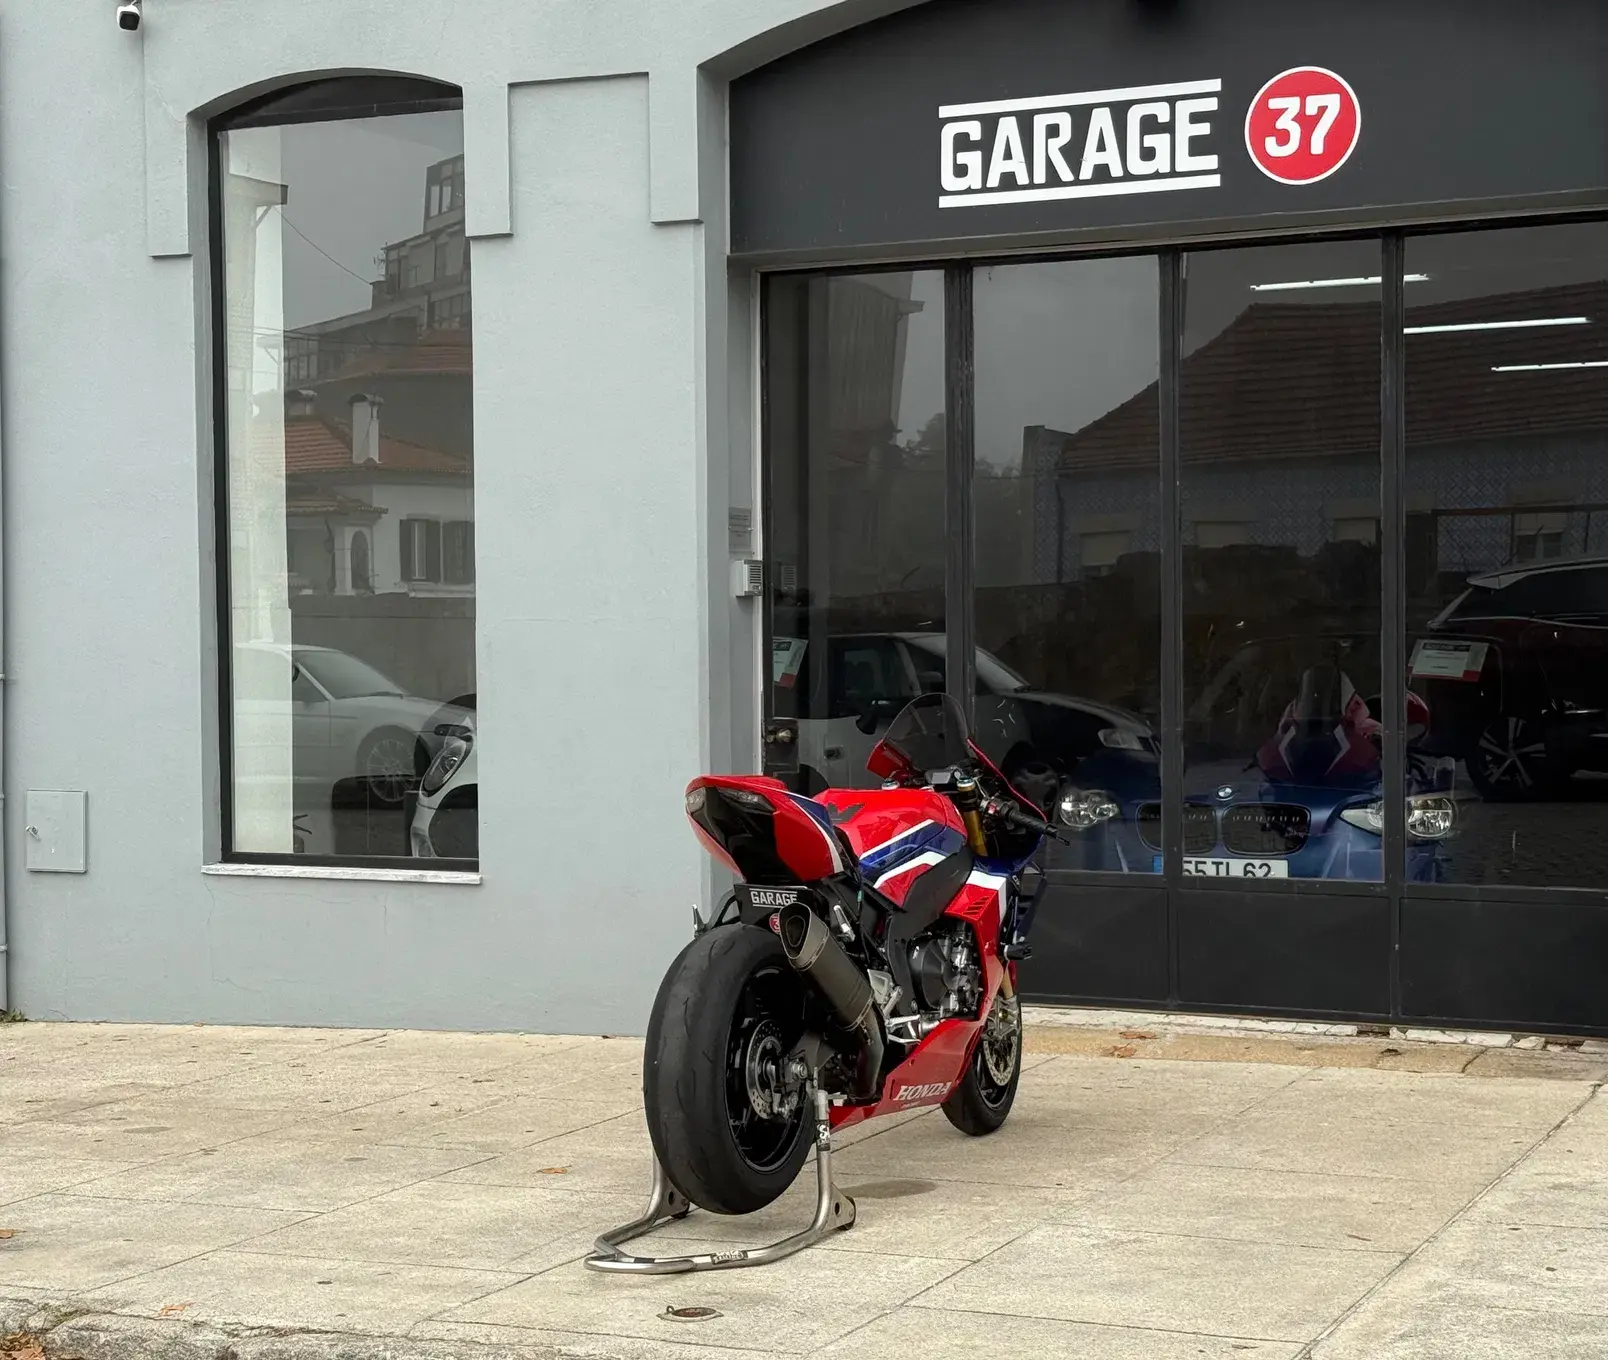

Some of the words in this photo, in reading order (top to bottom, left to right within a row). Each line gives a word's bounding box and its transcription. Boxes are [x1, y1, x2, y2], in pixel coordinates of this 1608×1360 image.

[940, 96, 1219, 192] GARAGE
[1264, 93, 1341, 158] 37
[750, 891, 798, 906] GARAGE
[893, 1081, 952, 1101] HONDA
